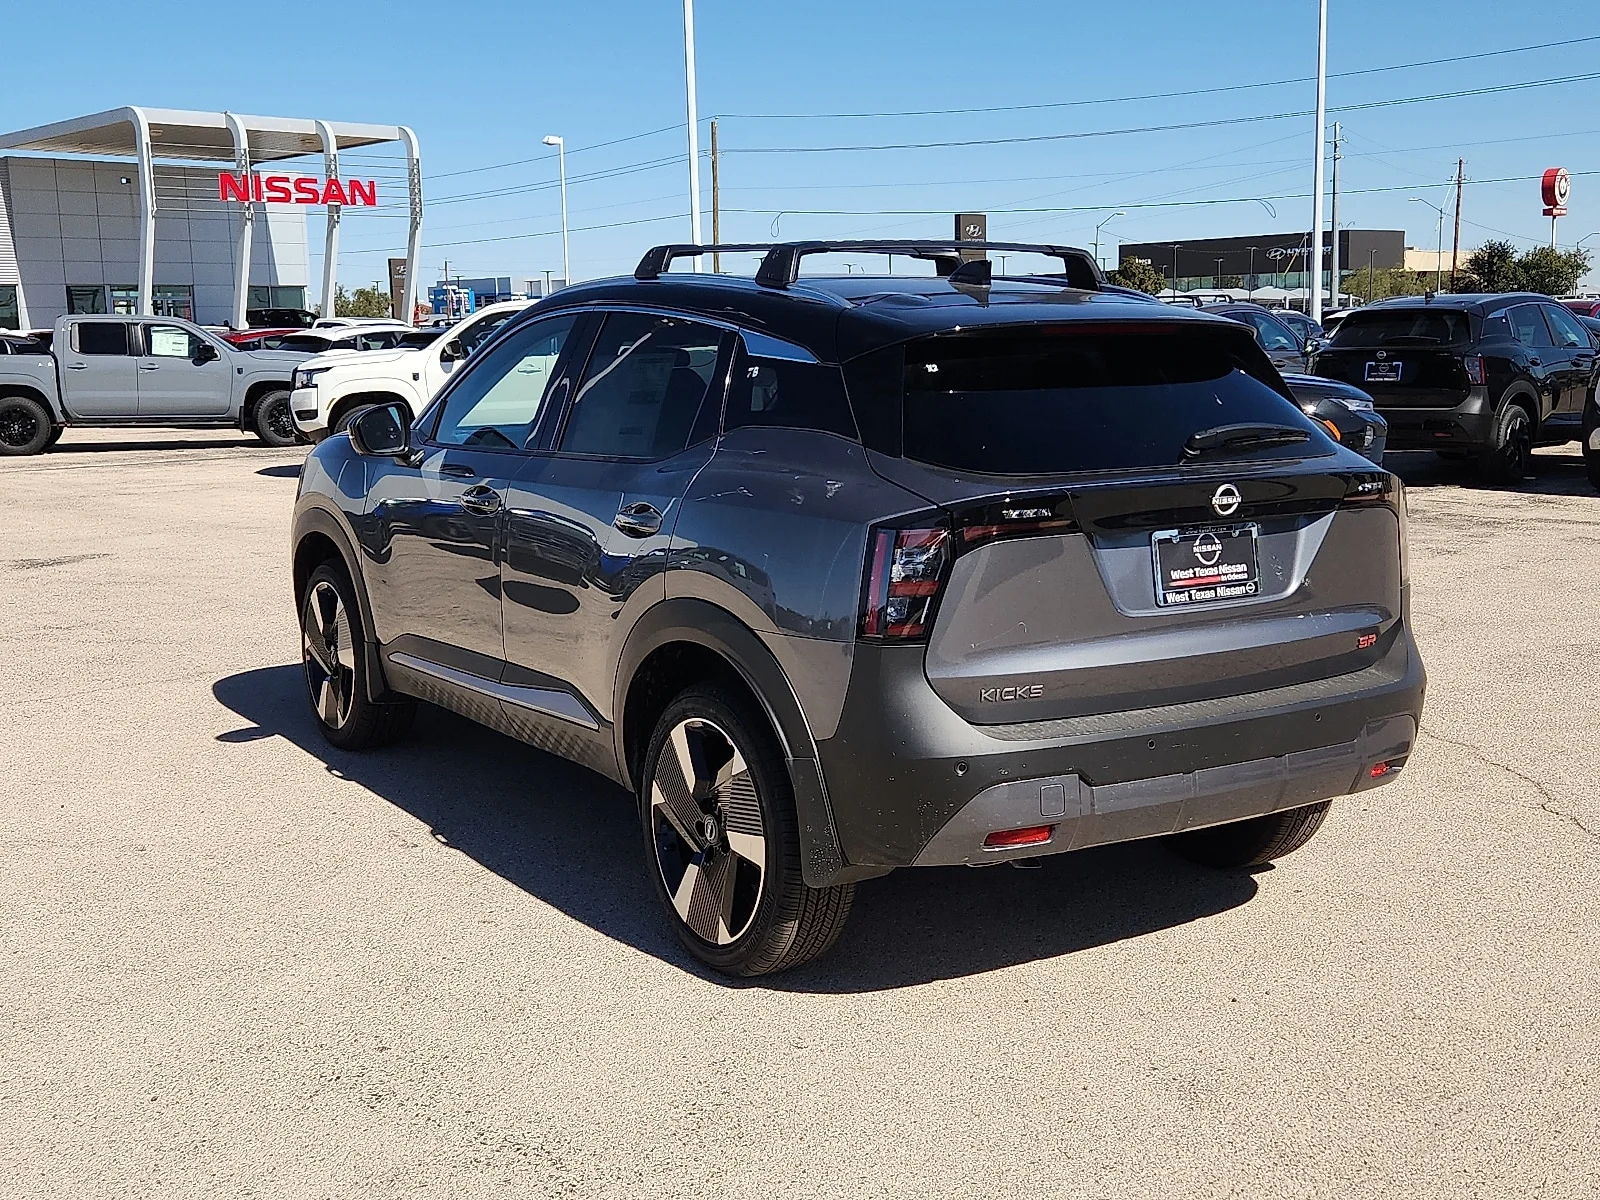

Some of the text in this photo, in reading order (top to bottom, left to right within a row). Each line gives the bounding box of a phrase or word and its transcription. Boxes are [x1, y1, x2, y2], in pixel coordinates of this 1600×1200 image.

[219, 173, 377, 206] NISSAN
[1211, 496, 1242, 505] NISSAN
[1193, 544, 1222, 553] NISSAN
[1170, 562, 1247, 579] West Texas Nissan
[1165, 585, 1246, 604] West Texas Nissan
[1357, 633, 1377, 649] SR
[980, 684, 1044, 703] KICKS
